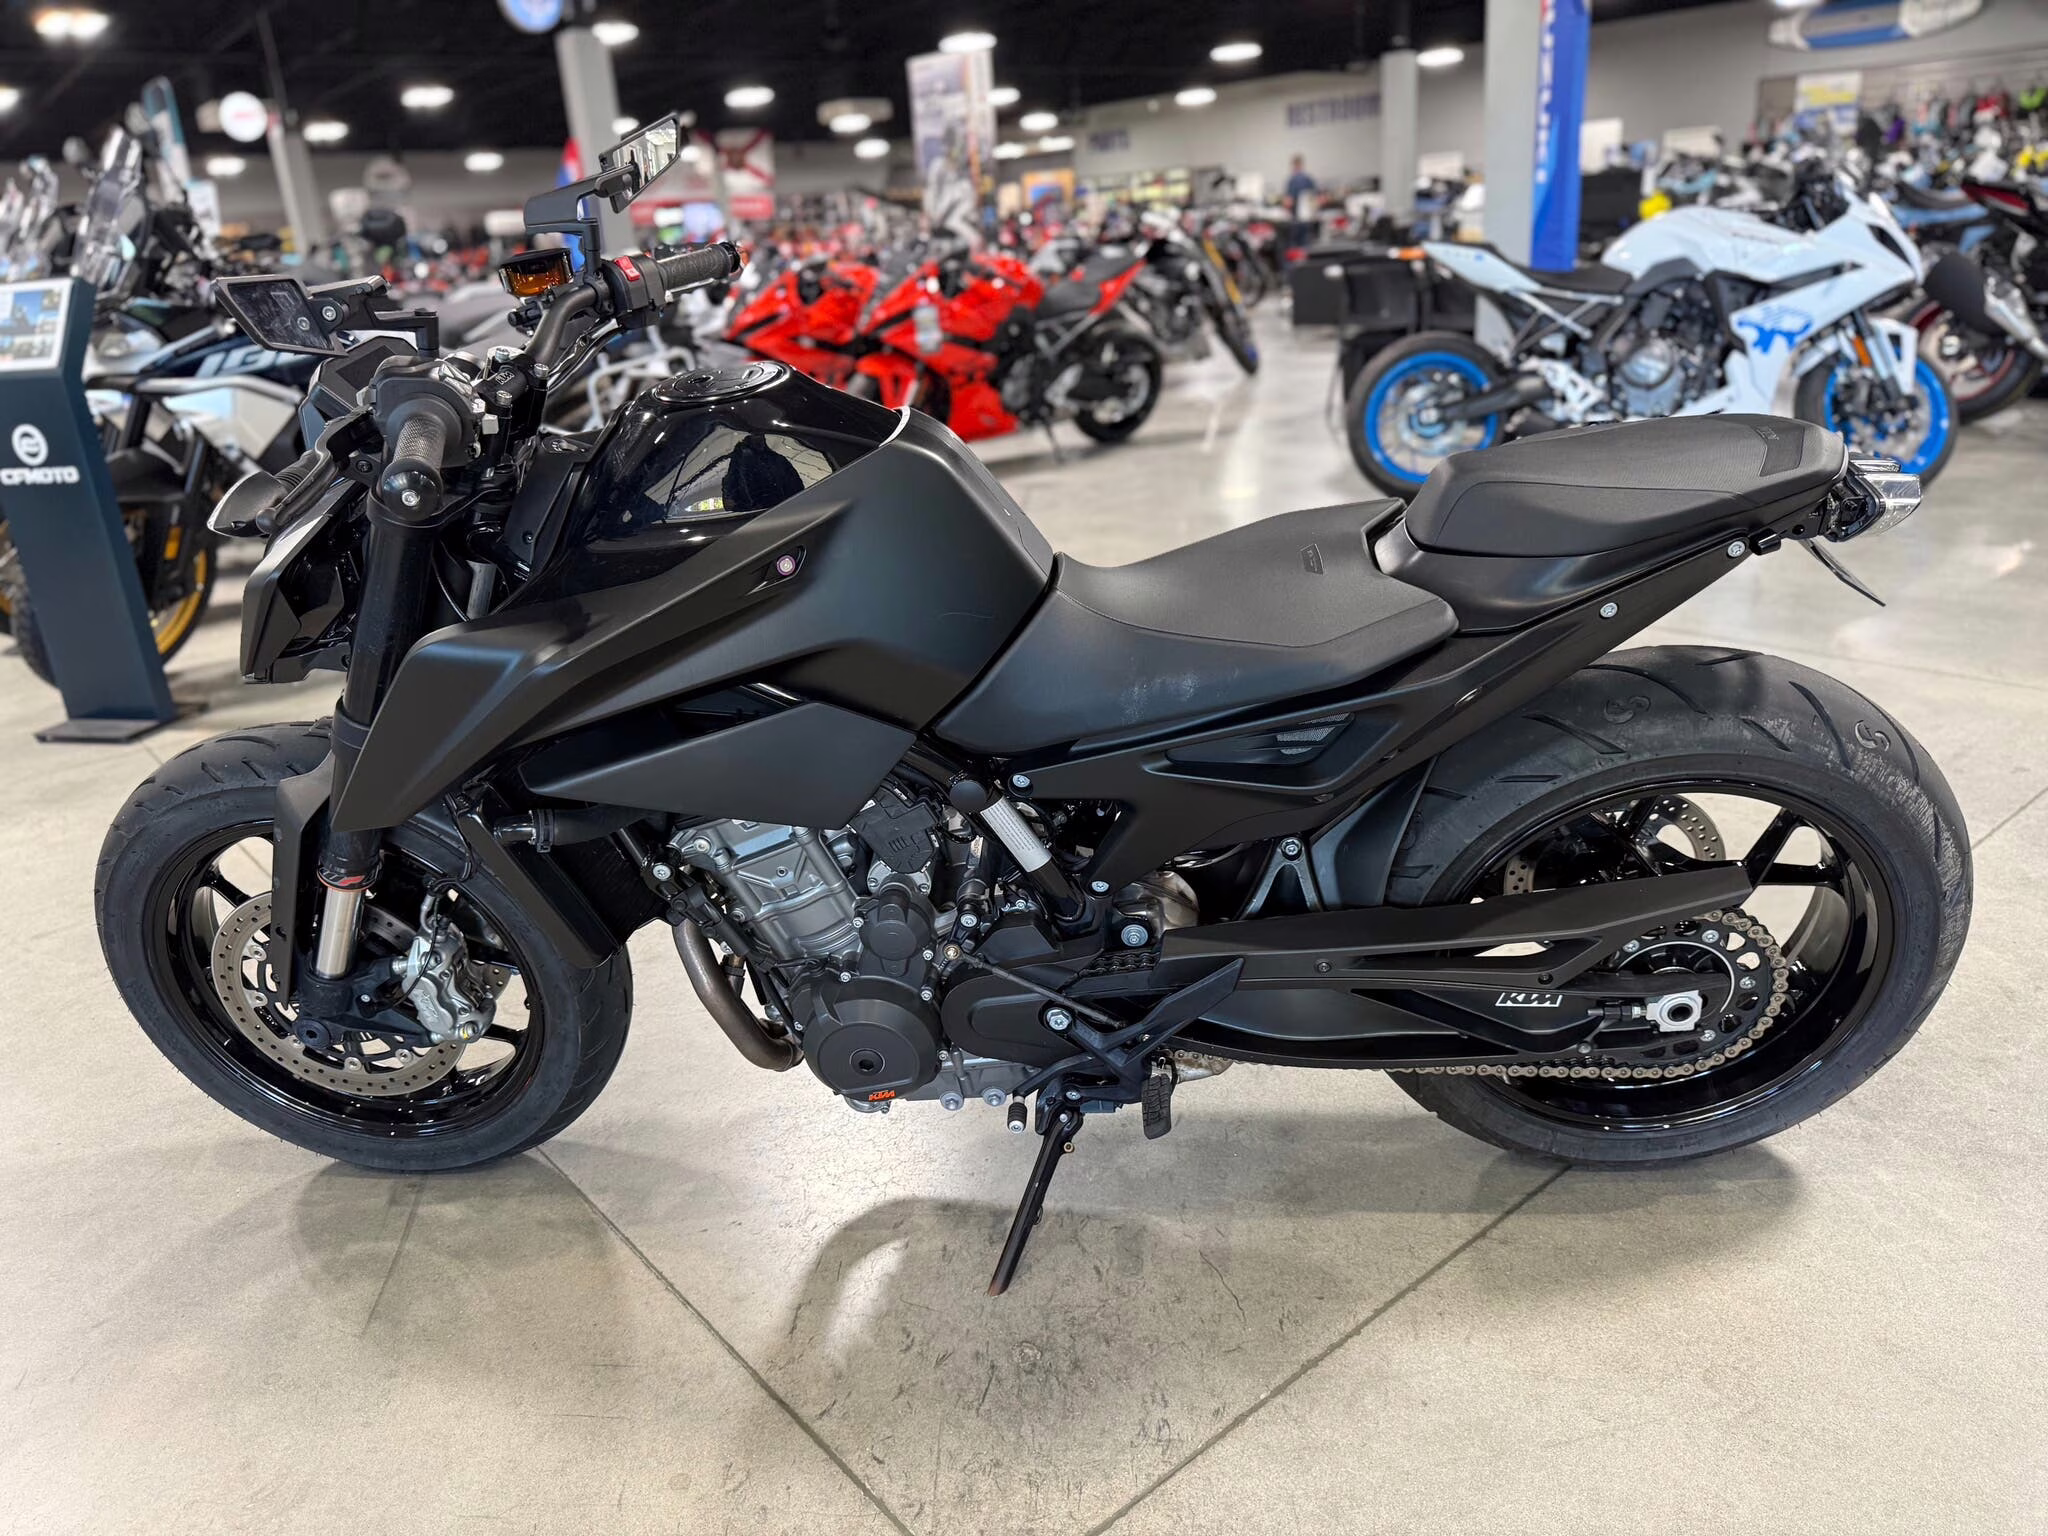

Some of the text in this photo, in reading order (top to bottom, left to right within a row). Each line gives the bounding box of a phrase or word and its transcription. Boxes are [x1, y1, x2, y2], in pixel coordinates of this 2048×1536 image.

[0, 465, 80, 486] CFMOTO
[1495, 992, 1562, 1007] KTM
[868, 1090, 895, 1101] KTM
